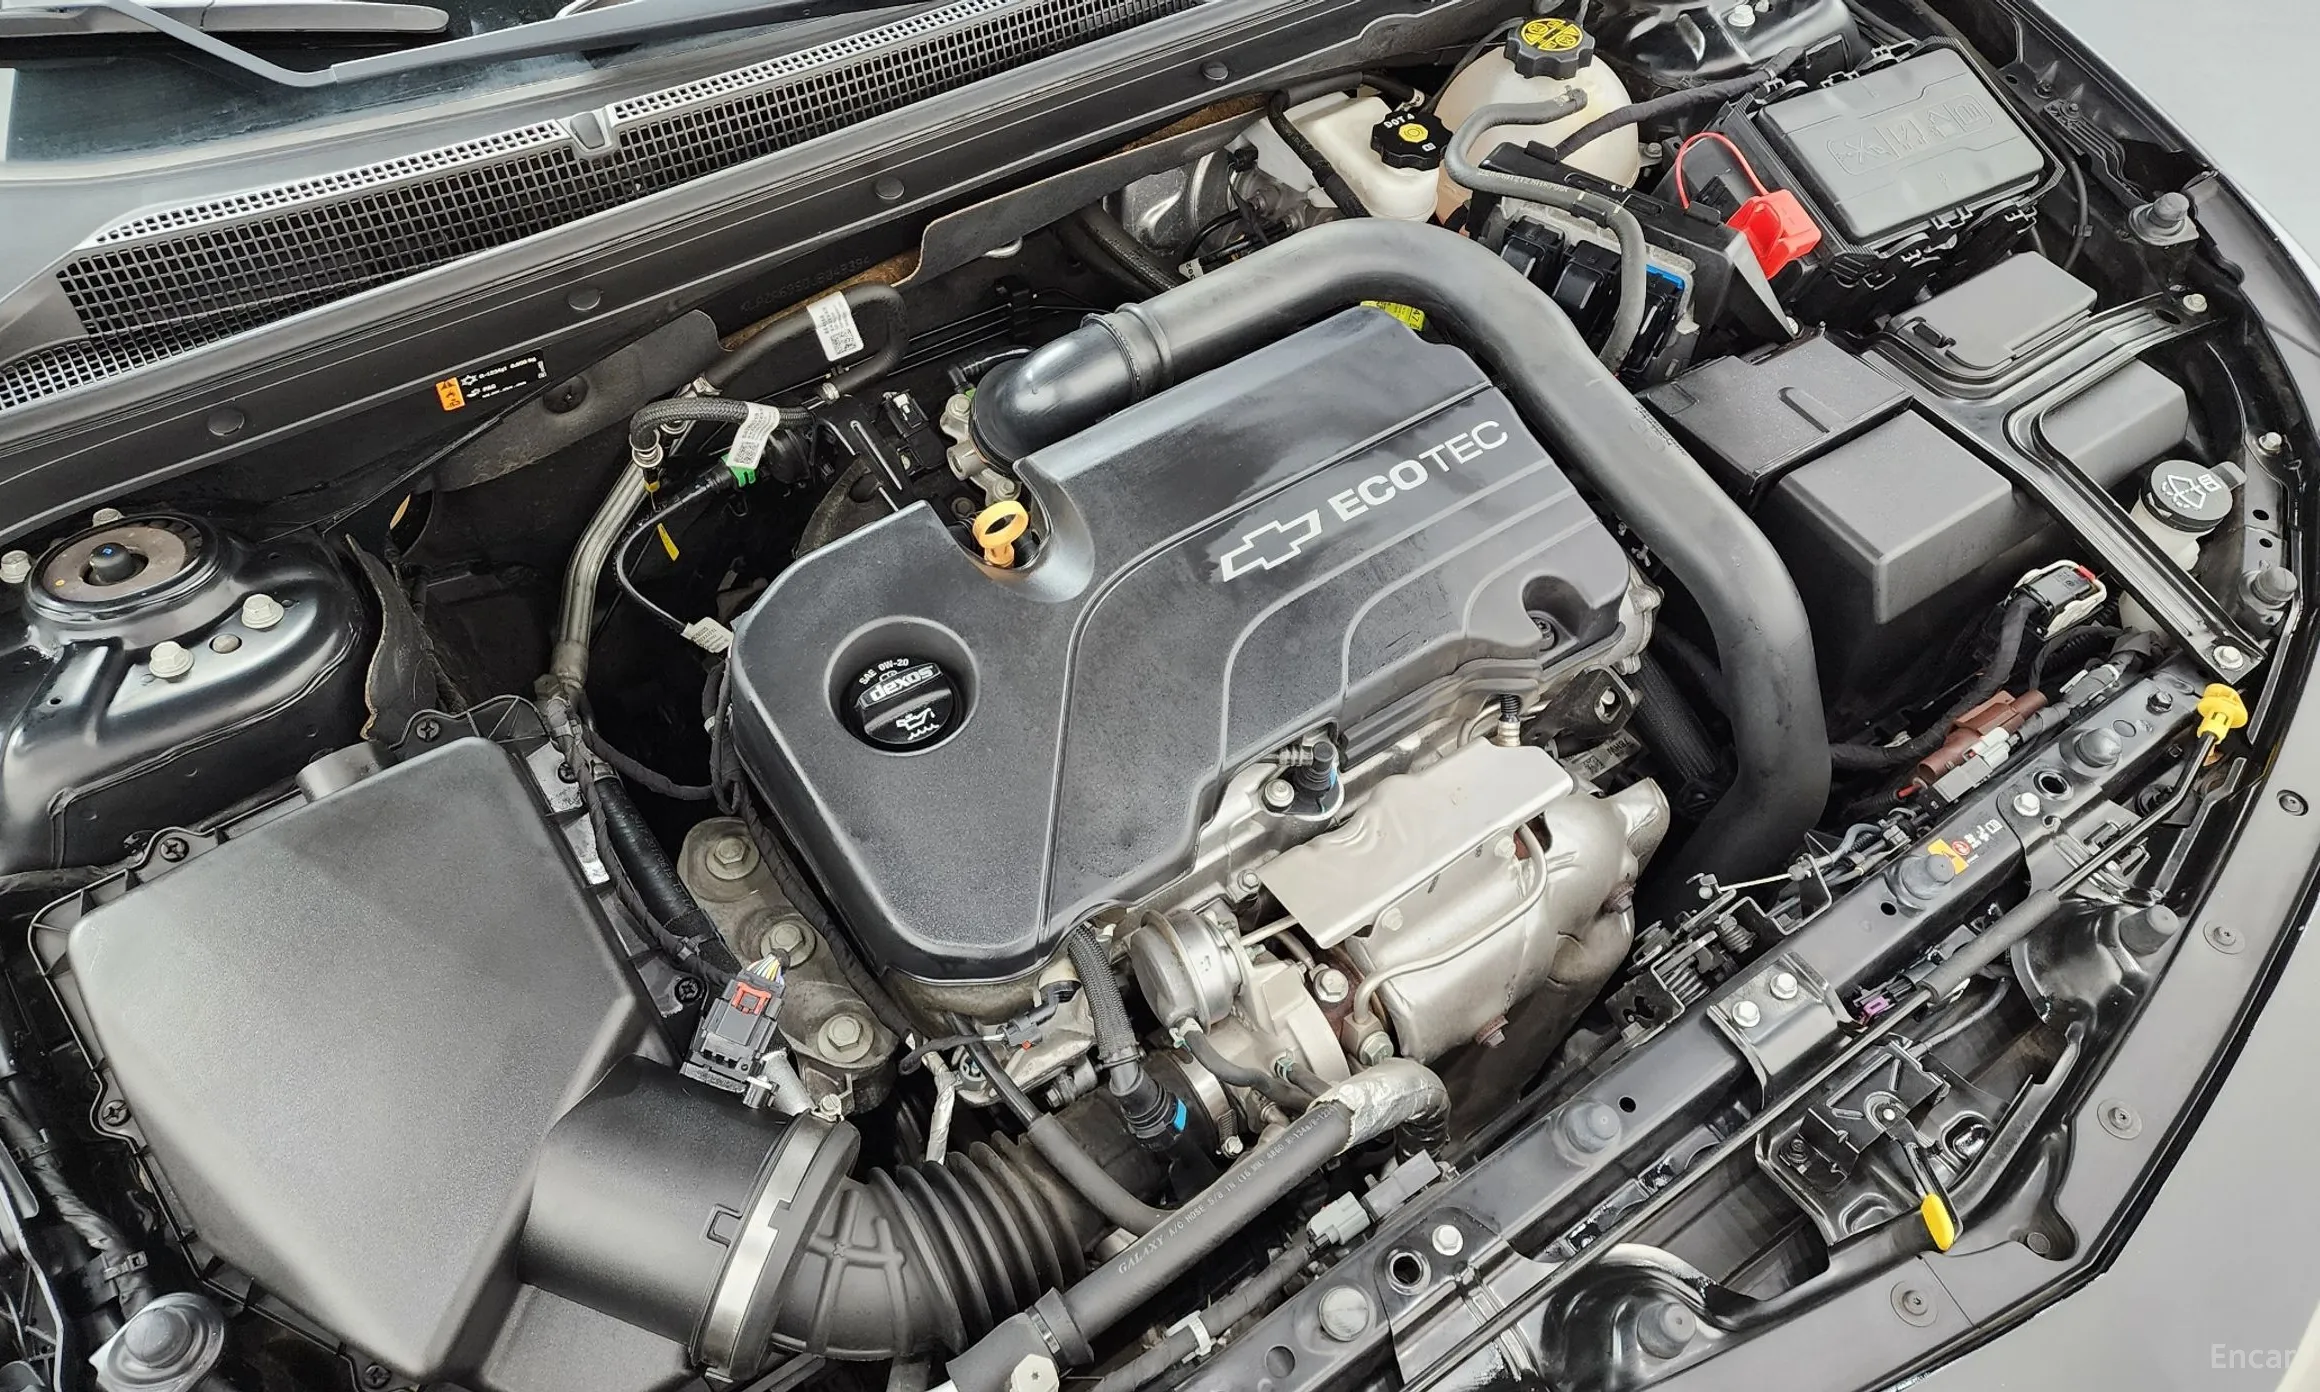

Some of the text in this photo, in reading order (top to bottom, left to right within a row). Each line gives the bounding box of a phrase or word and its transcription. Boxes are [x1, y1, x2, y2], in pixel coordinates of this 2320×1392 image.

[1383, 113, 1415, 129] DOT 4
[1327, 420, 1509, 522] ECOTEC
[858, 658, 909, 685] SAE 0W-20
[869, 665, 933, 702] dexos
[1118, 1234, 1165, 1275] GALAXY
[1168, 1220, 1184, 1238] A/C
[1185, 1204, 1205, 1224] HOSE
[1208, 1193, 1224, 1206] 5/8
[1237, 1169, 1251, 1183] (16
